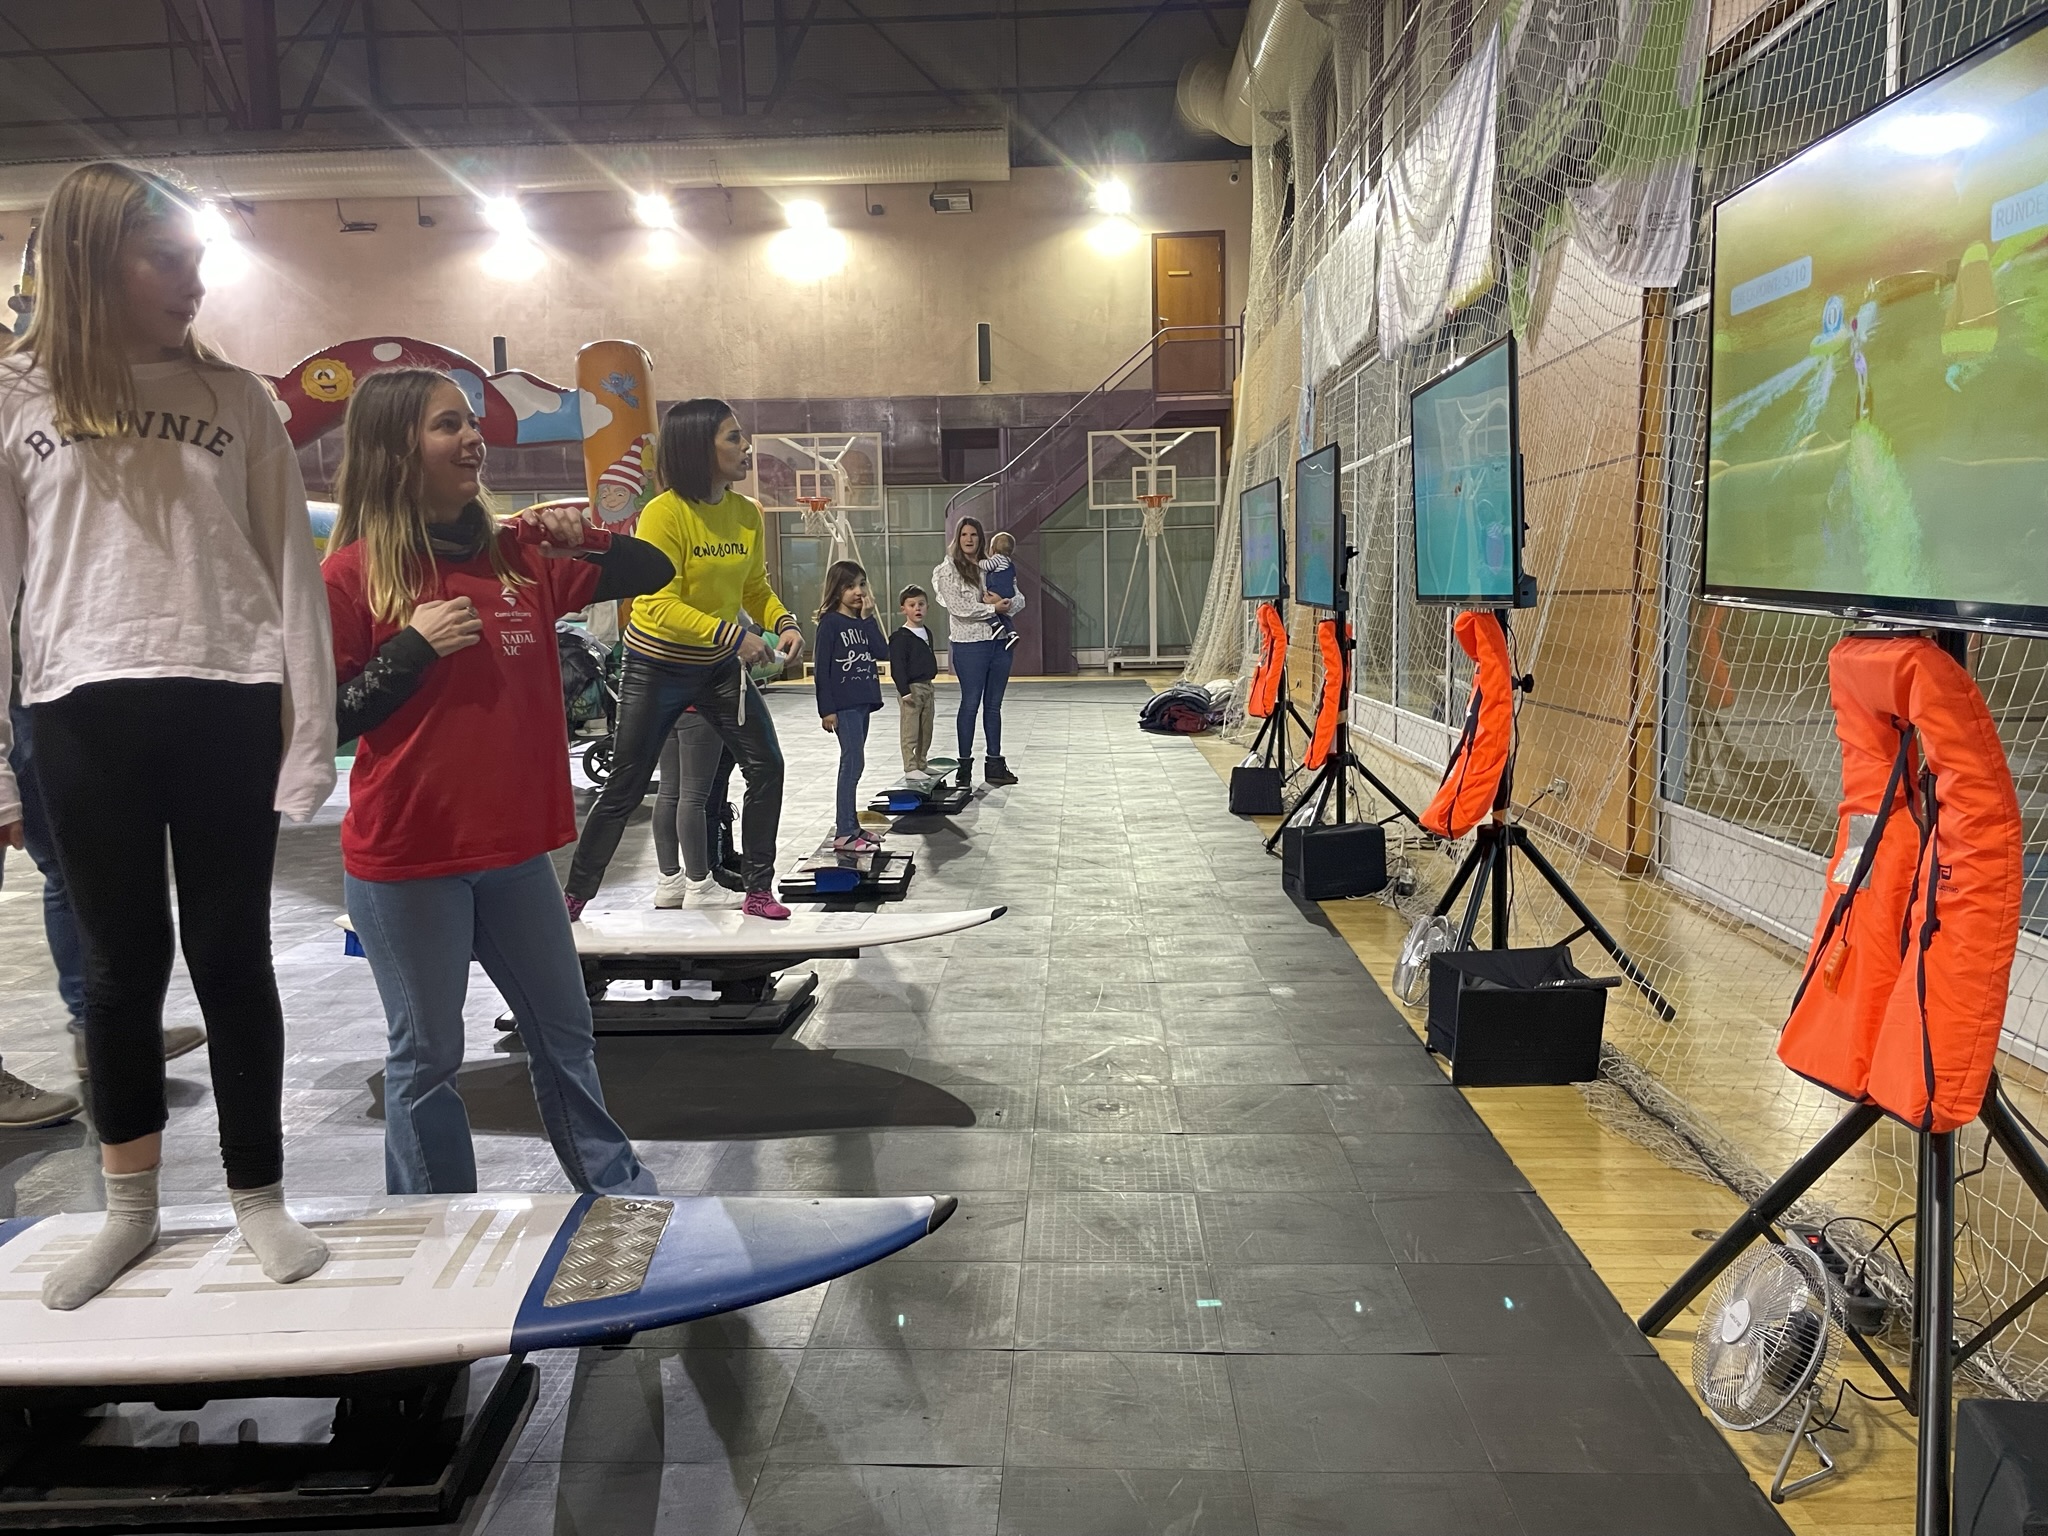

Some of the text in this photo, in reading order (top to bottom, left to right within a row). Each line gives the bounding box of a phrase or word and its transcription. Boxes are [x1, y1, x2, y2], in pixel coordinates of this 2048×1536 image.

[24, 409, 234, 462] BWNIE
[693, 541, 748, 558] awesome
[500, 632, 537, 645] NADAL
